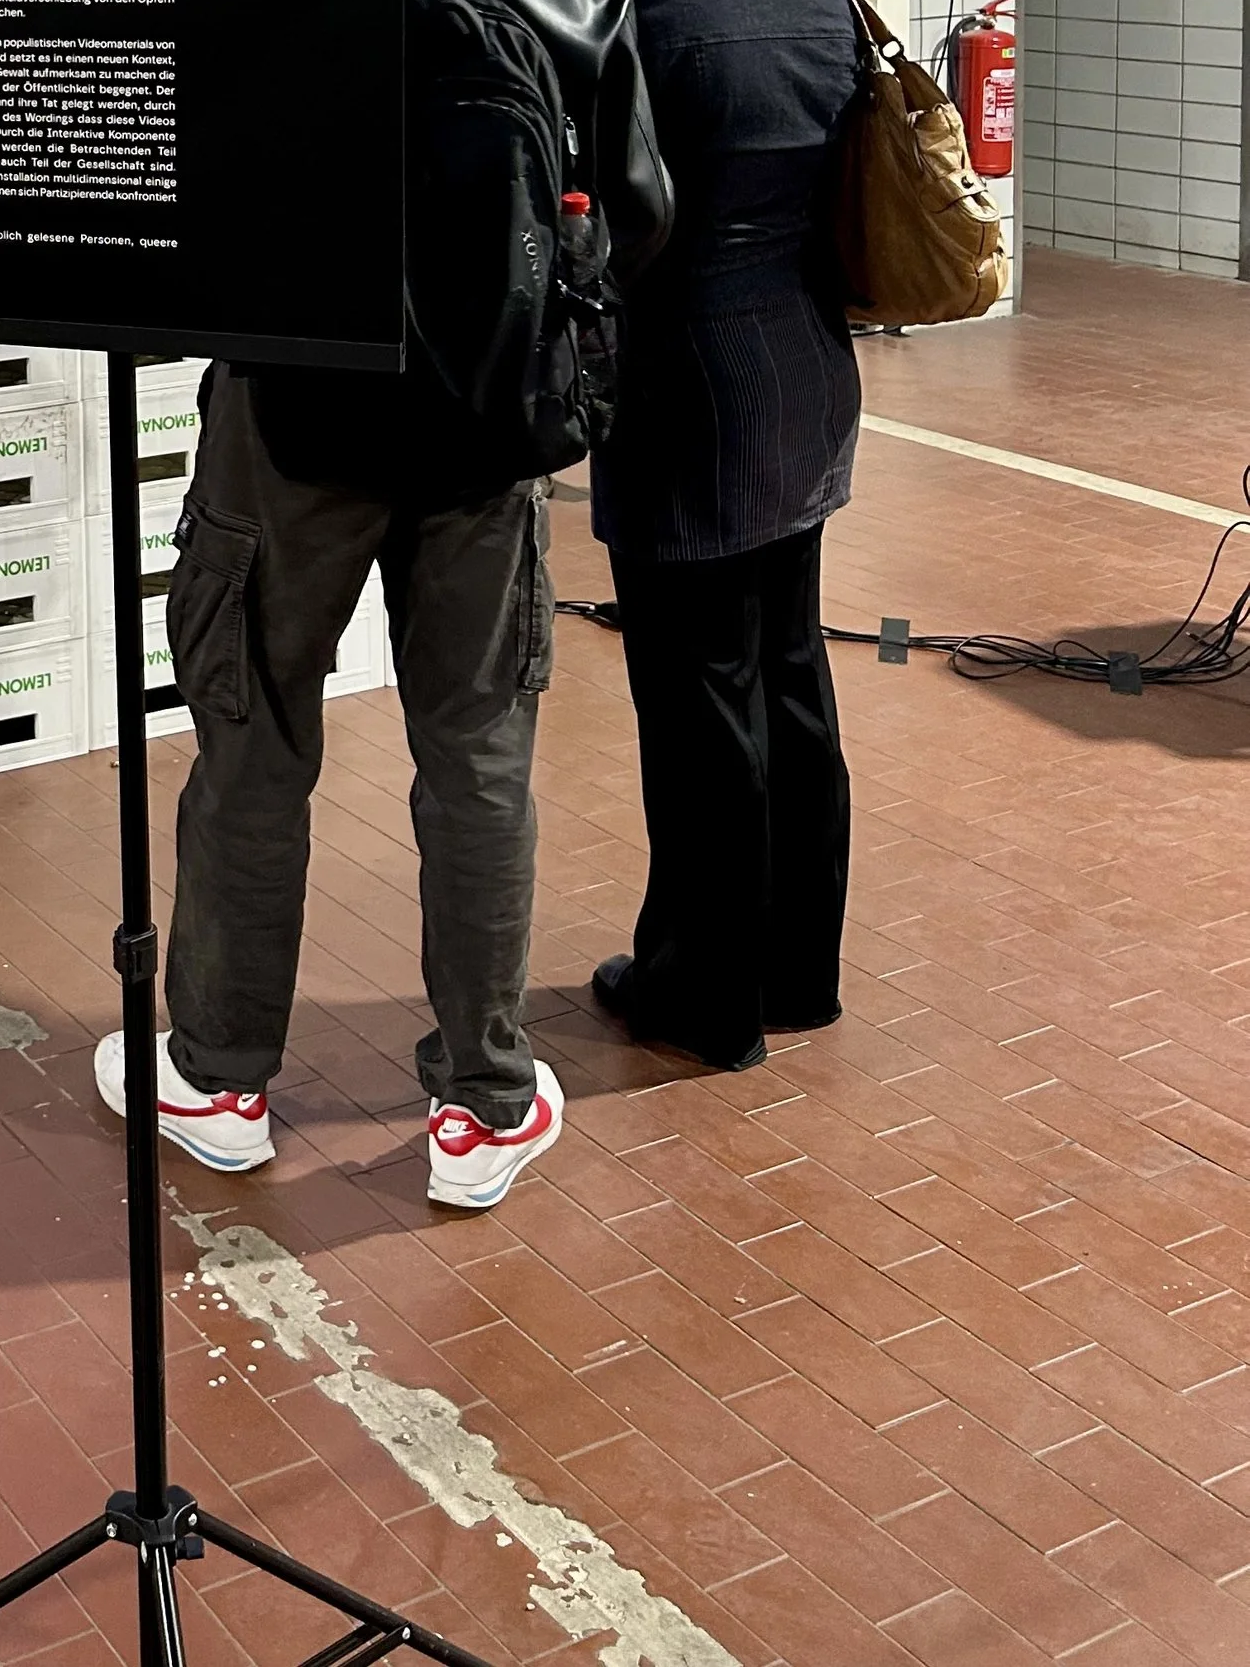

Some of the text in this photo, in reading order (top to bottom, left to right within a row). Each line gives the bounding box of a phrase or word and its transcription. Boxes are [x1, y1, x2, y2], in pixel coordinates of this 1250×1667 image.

[3, 37, 76, 49] populistischen
[77, 38, 154, 49] Videomaterials
[9, 53, 36, 62] setzt
[65, 54, 94, 63] einen
[96, 56, 129, 64] neuen
[131, 54, 176, 66] Kontext,
[32, 67, 97, 78] aufmerksam
[113, 69, 156, 79] machen
[22, 81, 96, 93] Öffentlichkeit
[98, 84, 152, 97] begegnet.
[17, 97, 38, 107] ihre
[61, 98, 94, 111] gelegt
[97, 99, 140, 111] werden,
[143, 100, 176, 110] durch
[24, 112, 74, 125] Wordings
[76, 114, 103, 124] dass
[105, 114, 136, 125] diese
[138, 115, 176, 126] Videos
[46, 127, 105, 139] Interaktive
[108, 130, 176, 143] Komponente
[1, 142, 42, 152] werden
[69, 144, 152, 155] Betrachtenden
[157, 146, 177, 156] Teil
[0, 157, 27, 166] auch
[30, 157, 49, 167] Teil
[76, 158, 145, 170] Gesellschaft
[149, 161, 176, 171] sind.
[52, 173, 142, 185] multidimensional
[144, 176, 177, 189] einige
[17, 187, 39, 196] sich
[39, 187, 115, 201] Partizipierende
[115, 190, 177, 202] konfrontiert
[26, 232, 75, 245] gelesene
[80, 234, 134, 246] Personen,
[139, 238, 178, 249] queere
